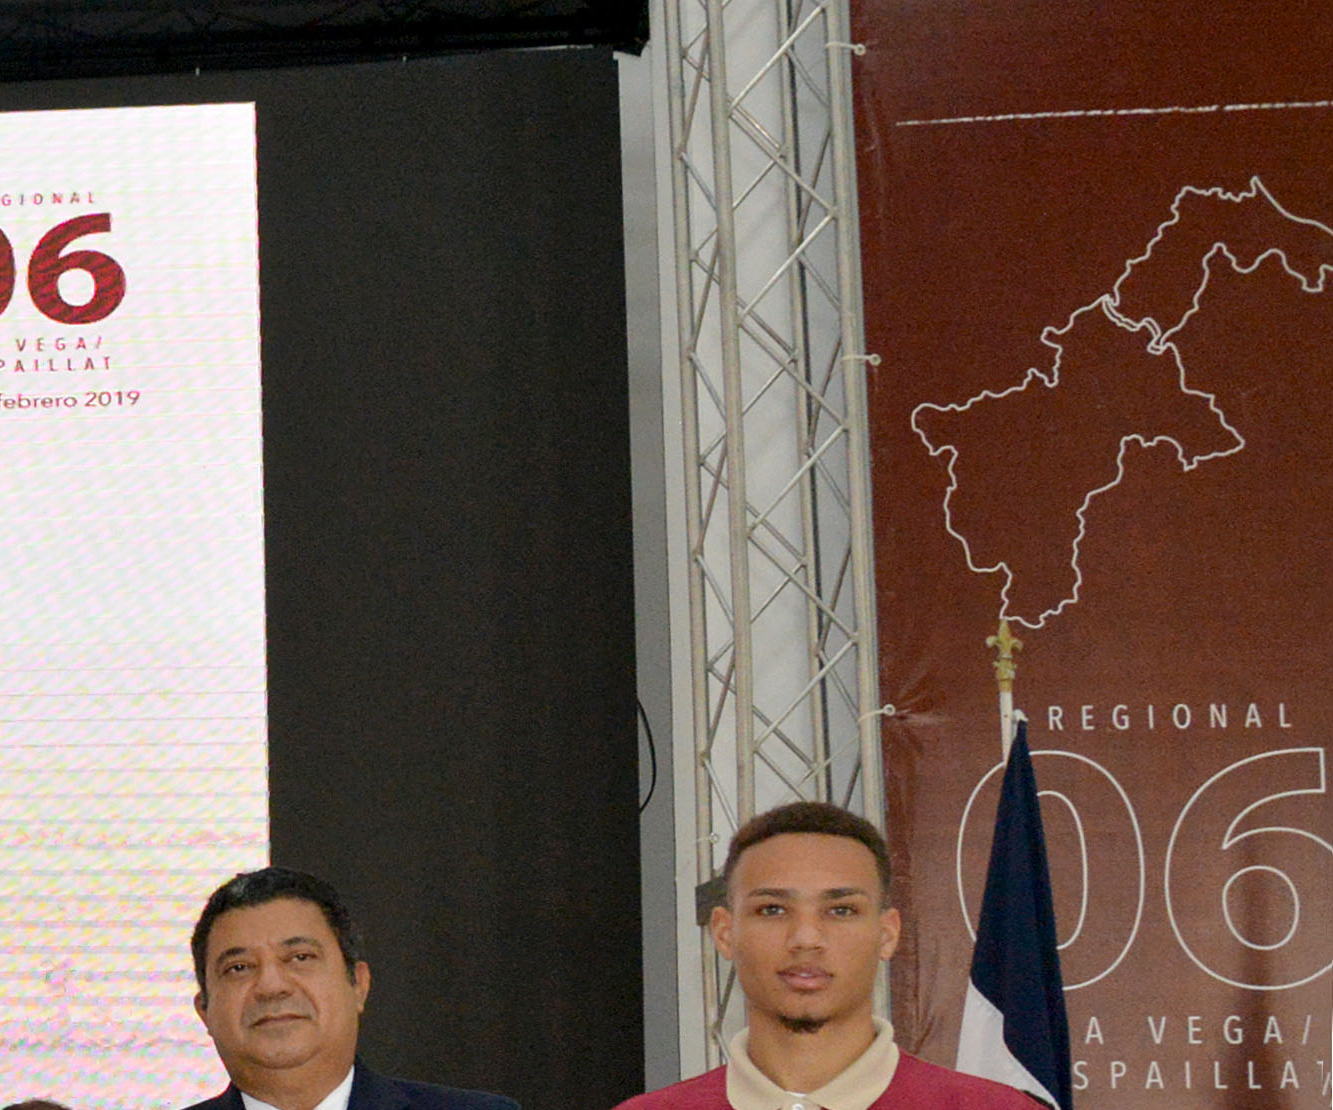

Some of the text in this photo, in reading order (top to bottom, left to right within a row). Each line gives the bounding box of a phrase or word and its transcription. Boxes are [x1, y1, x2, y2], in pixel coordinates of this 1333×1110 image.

[16, 336, 103, 351] VEGA/
[84, 390, 141, 407] 2019
[1048, 703, 1294, 731] REGIONAL
[957, 747, 1332, 992] 06
[1147, 1015, 1312, 1045] VEGA/
